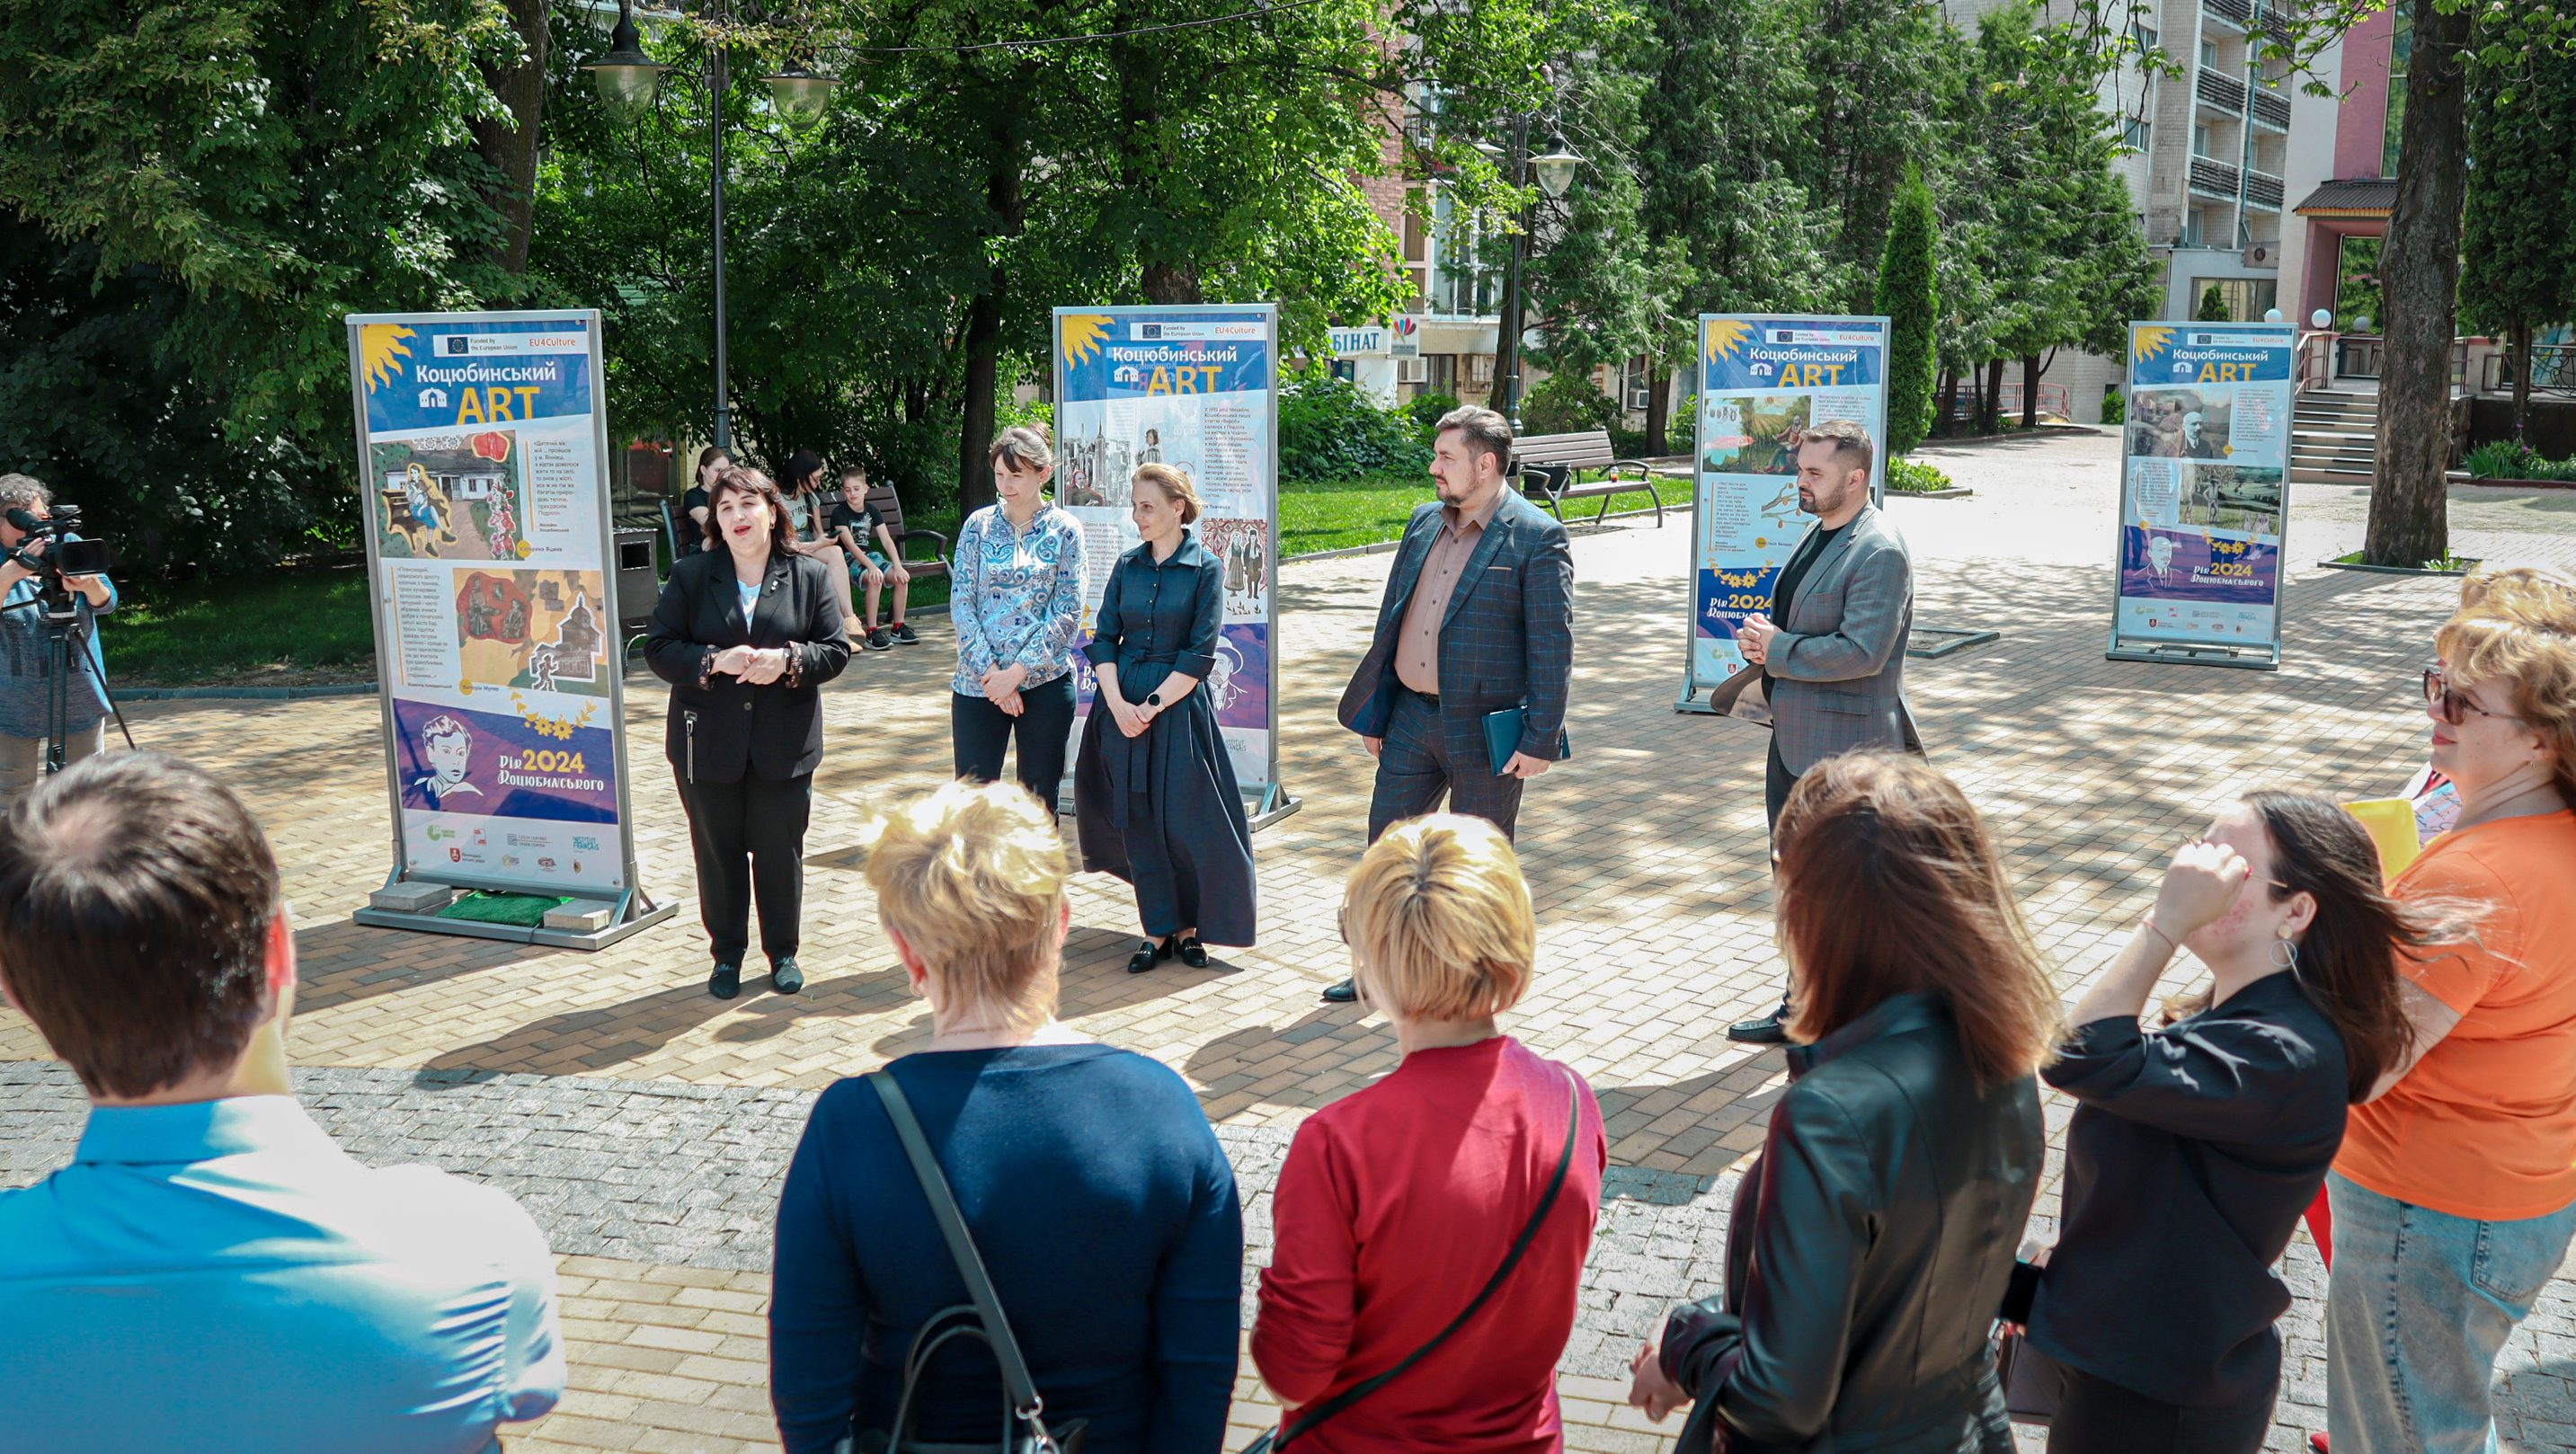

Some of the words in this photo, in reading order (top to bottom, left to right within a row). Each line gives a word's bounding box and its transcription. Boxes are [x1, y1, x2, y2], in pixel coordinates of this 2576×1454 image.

[1214, 326, 1256, 334] EU4Culture
[529, 338, 576, 347] EU4Culture
[1113, 346, 1238, 366] Коцюбинський
[1750, 348, 1858, 363] Коцюбинський
[2172, 349, 2269, 362] Коцюбинський
[416, 360, 556, 387] Коцюбинський
[1147, 366, 1223, 397] ART
[1778, 363, 1845, 388] ART
[2198, 362, 2257, 383] ART
[457, 386, 541, 425] ART
[2210, 562, 2253, 577] 2024
[522, 749, 586, 774] 2024
[497, 769, 604, 792] Коцюбинського
